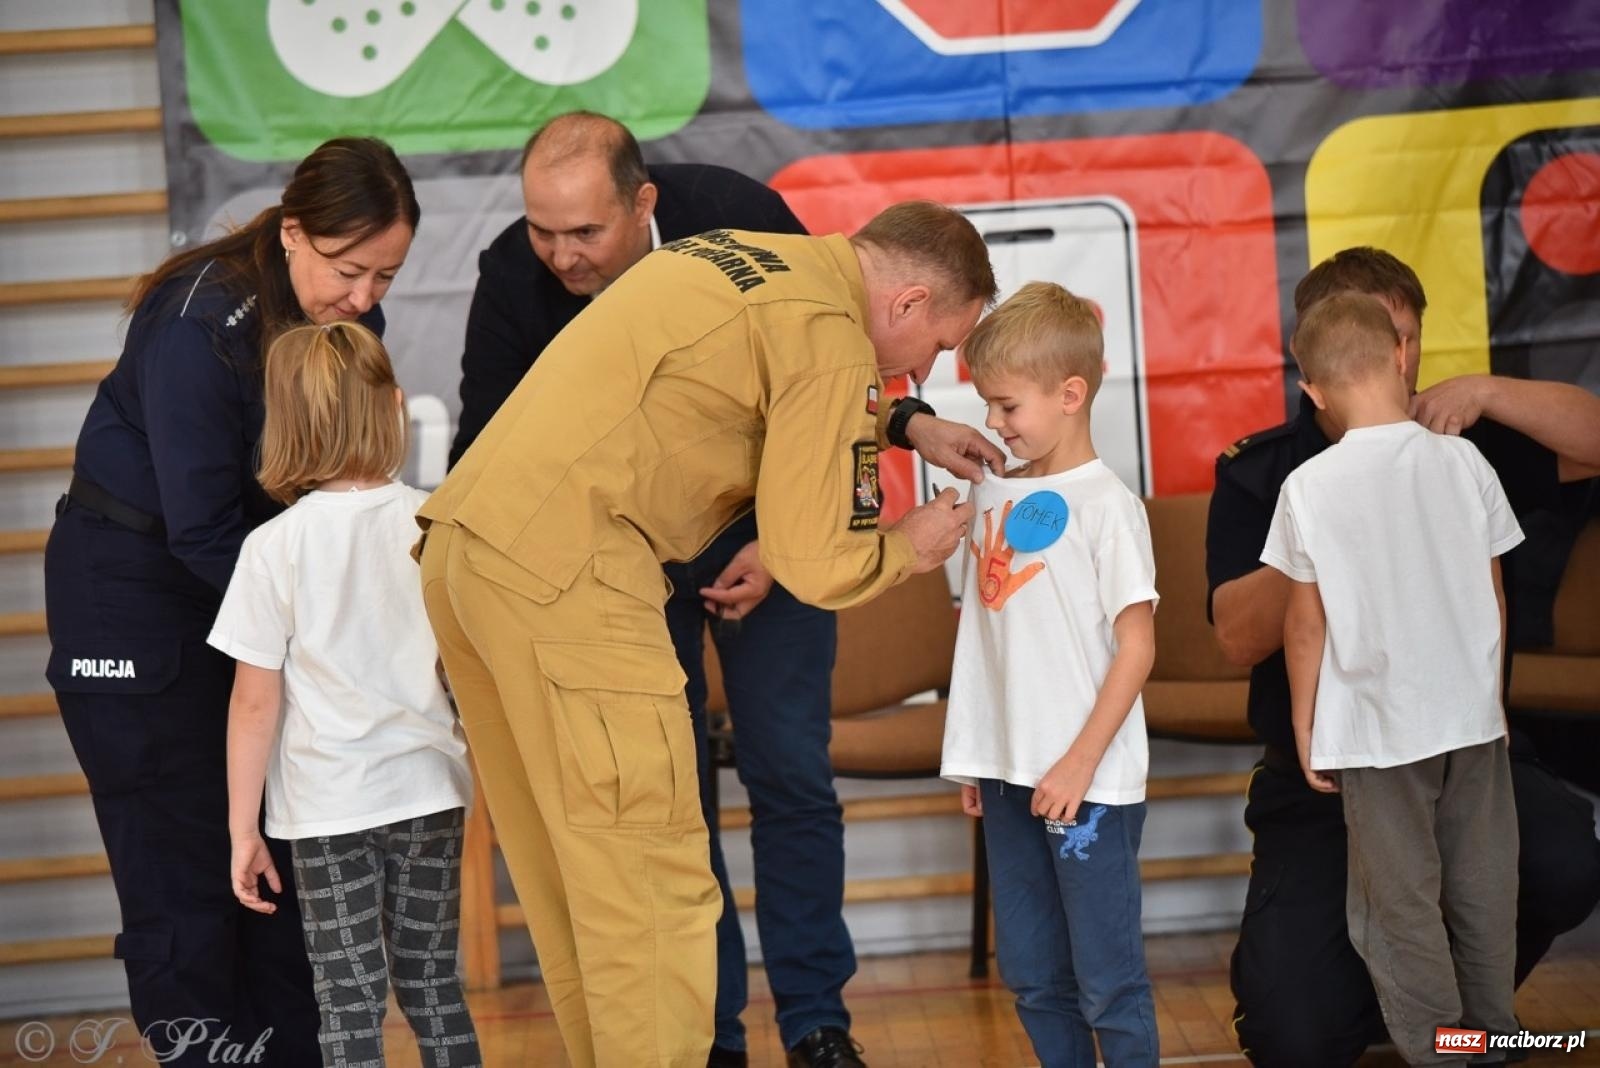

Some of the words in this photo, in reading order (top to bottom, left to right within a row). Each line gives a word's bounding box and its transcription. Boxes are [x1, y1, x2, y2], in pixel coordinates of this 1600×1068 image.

[1015, 502, 1065, 531] TOMEK
[981, 557, 1006, 603] 5
[71, 658, 136, 679] POLICJA
